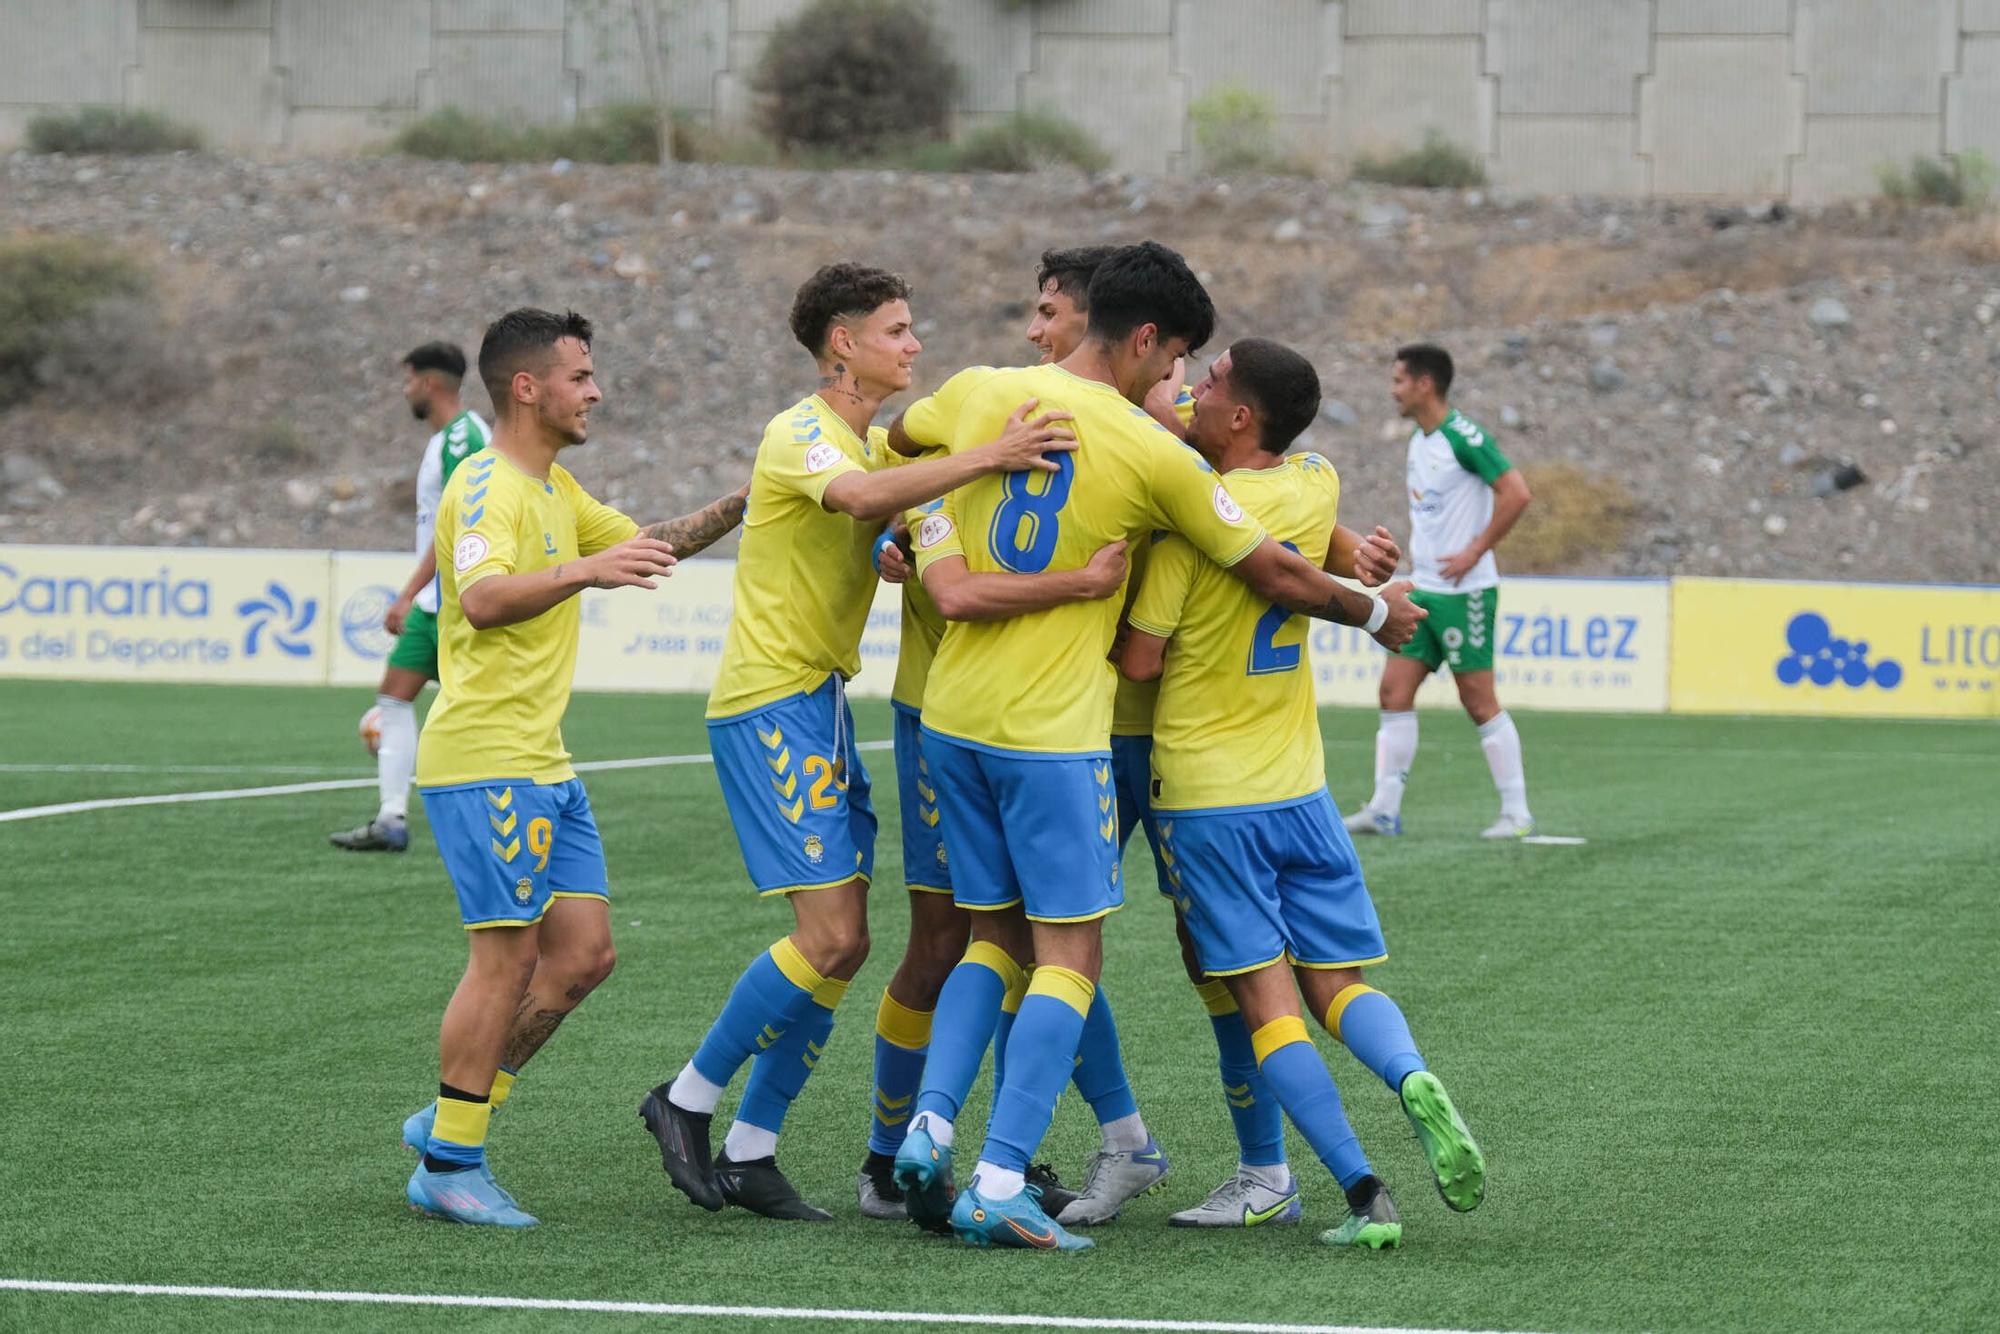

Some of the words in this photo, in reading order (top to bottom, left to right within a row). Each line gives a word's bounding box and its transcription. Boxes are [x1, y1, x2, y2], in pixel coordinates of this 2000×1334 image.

[988, 449, 1074, 574] 8
[20, 632, 76, 660] del
[87, 633, 230, 664] Deporte
[526, 817, 552, 873] 9
